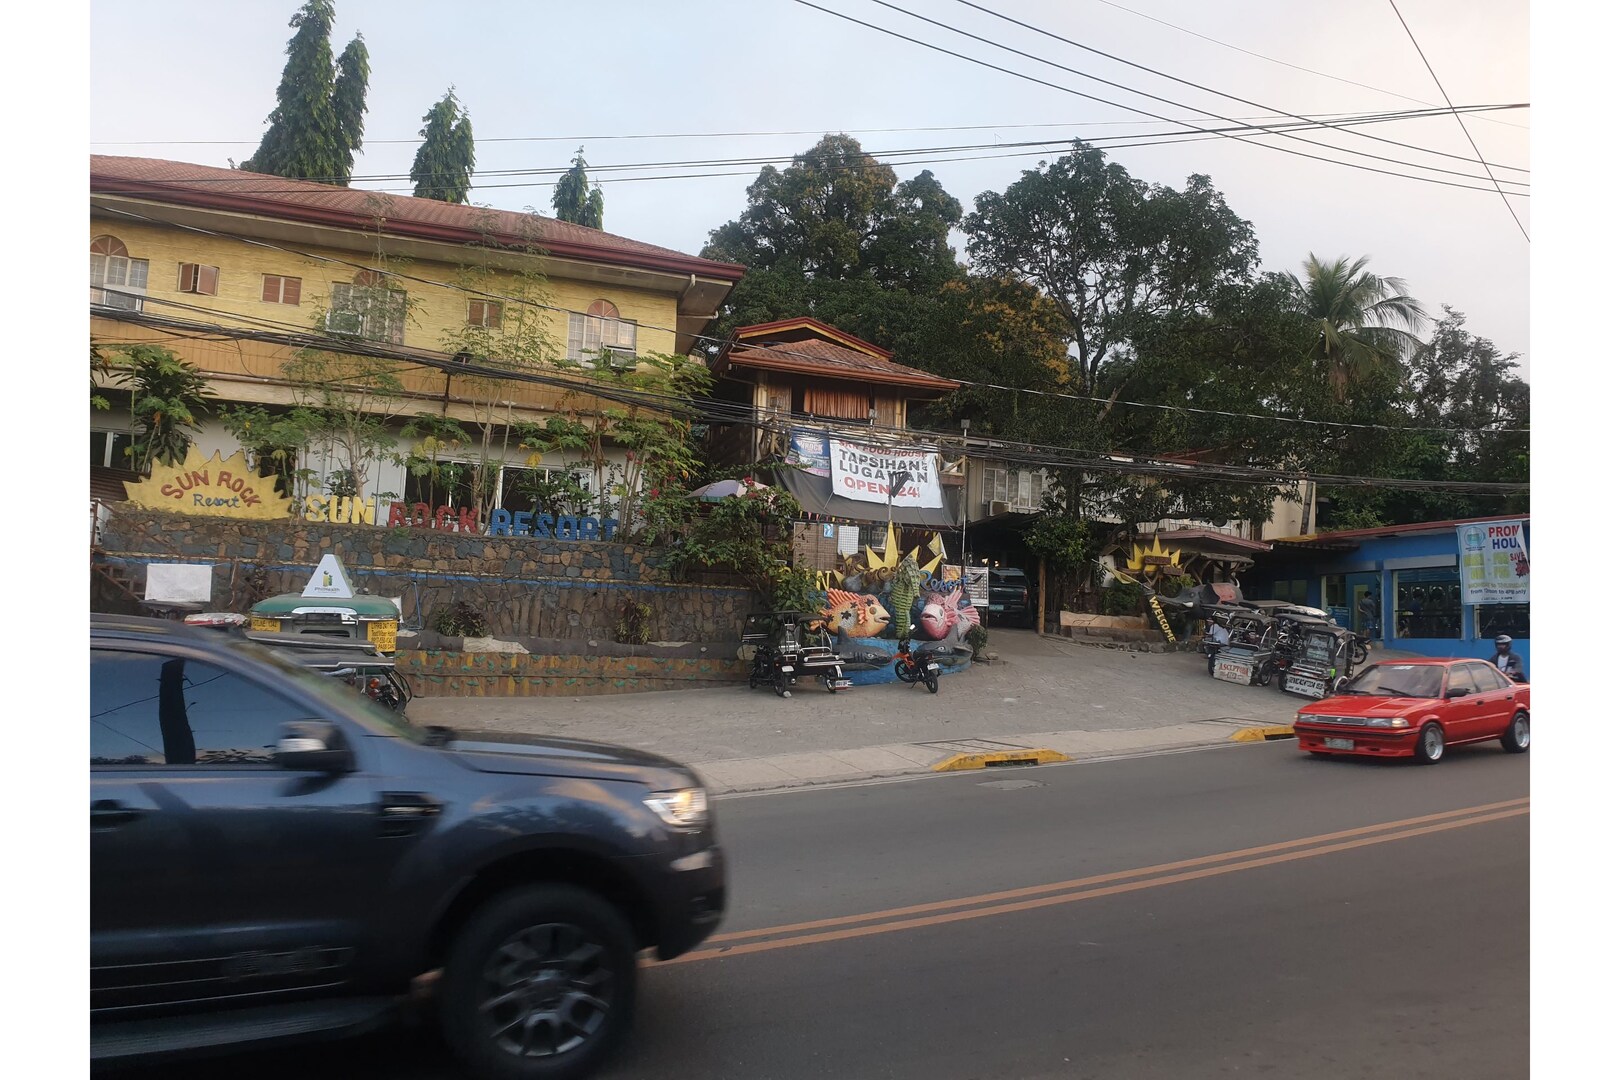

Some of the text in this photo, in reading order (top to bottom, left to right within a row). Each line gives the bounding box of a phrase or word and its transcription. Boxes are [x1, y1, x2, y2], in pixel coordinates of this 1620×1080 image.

[839, 449, 920, 471] TAPSIHAN
[863, 446, 890, 456] FOOD
[893, 449, 928, 458] HOUSE
[922, 461, 928, 471] AT
[160, 469, 262, 507] SUN ROCK
[844, 476, 890, 494] OPEN
[193, 493, 242, 508] Resort
[305, 494, 620, 541] SUN ROCK RESORT
[1149, 595, 1176, 643] WELCOME
